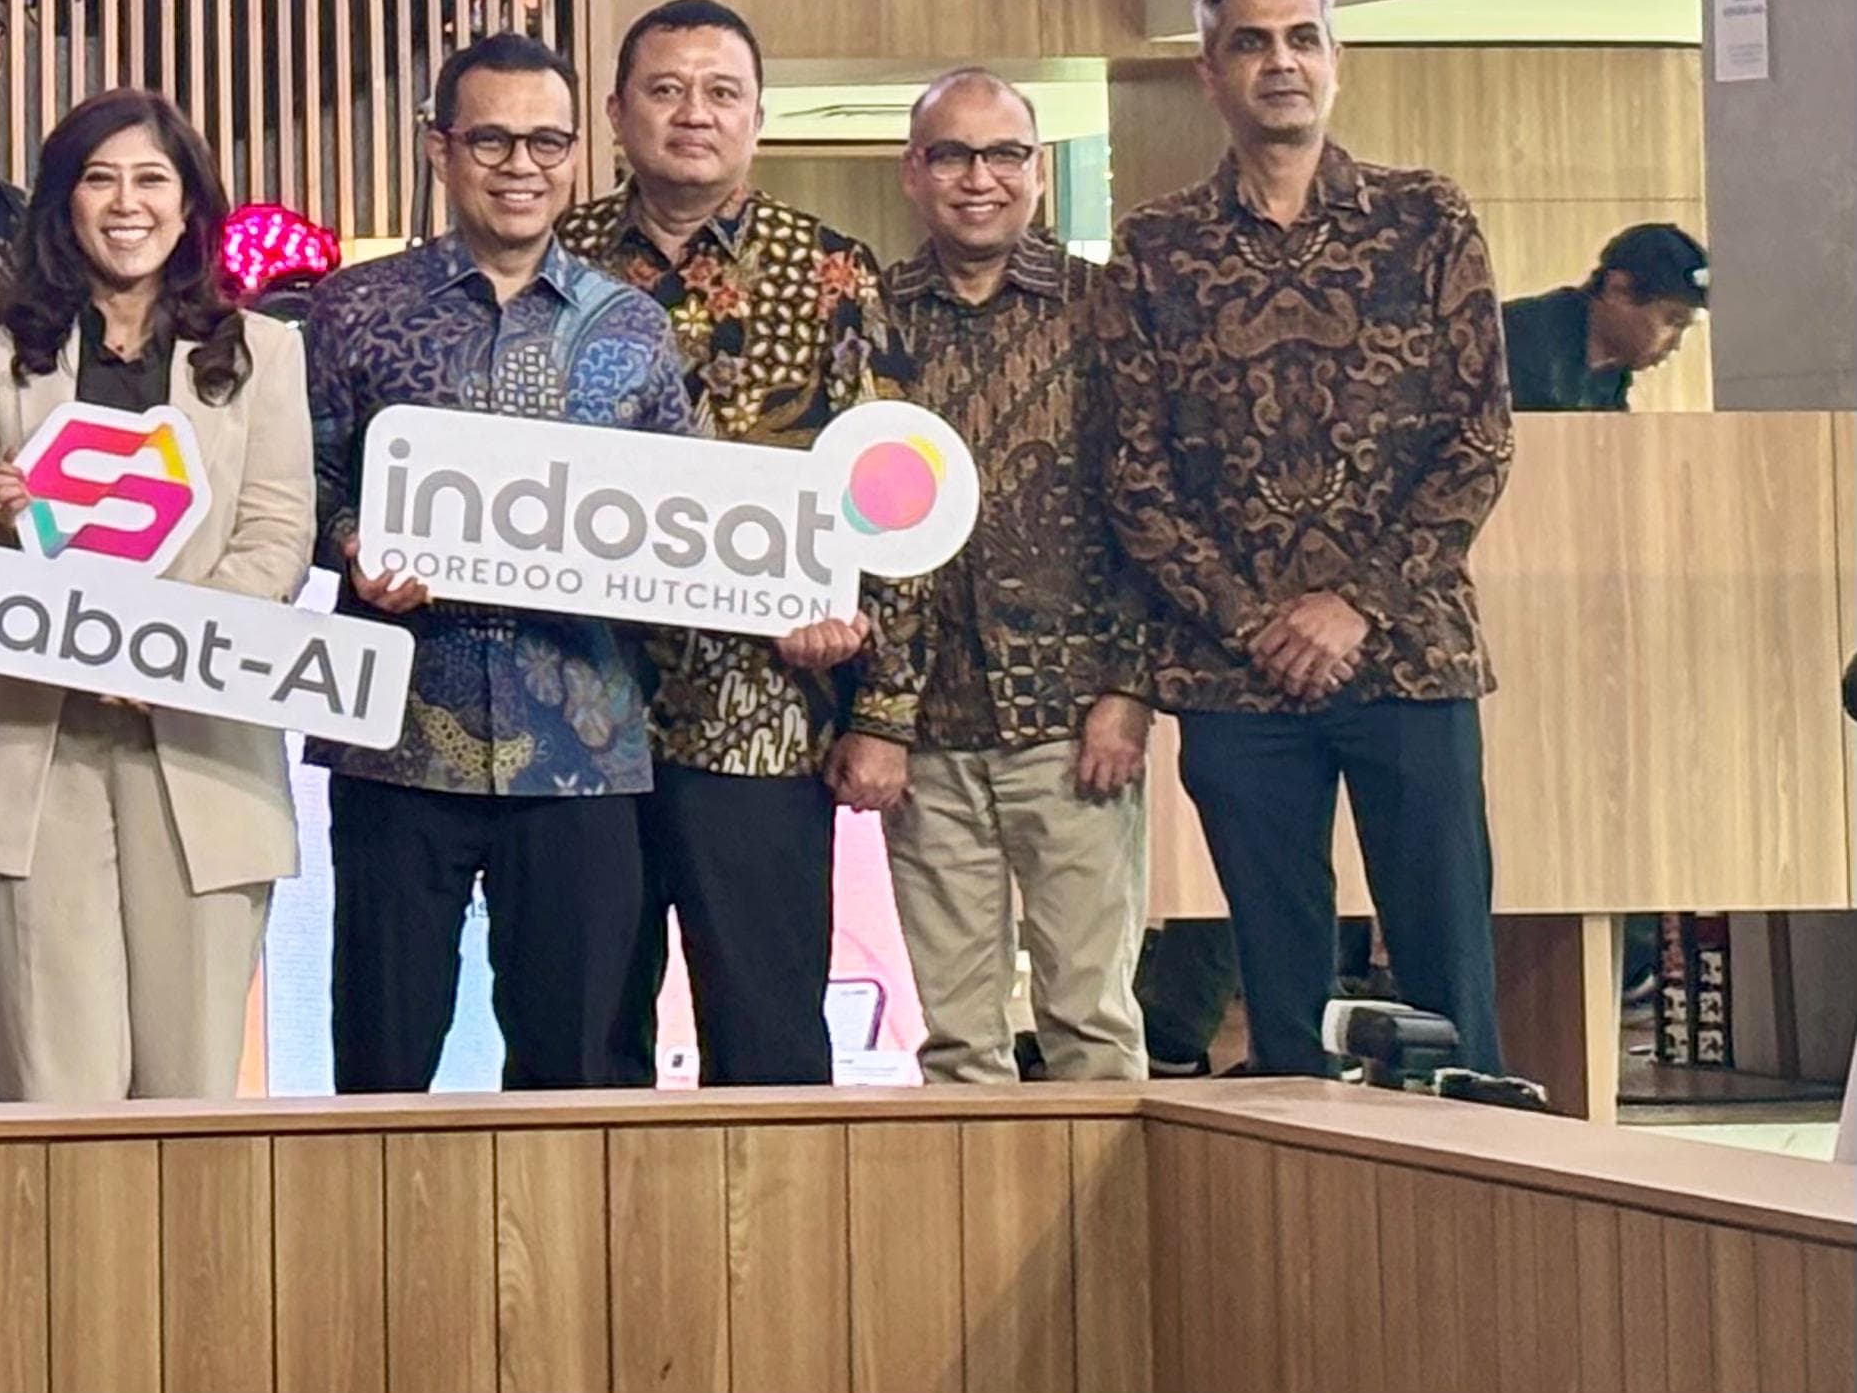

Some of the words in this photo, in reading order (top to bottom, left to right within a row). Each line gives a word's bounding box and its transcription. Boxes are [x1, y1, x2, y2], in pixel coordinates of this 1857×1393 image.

[383, 437, 836, 587] indosat
[380, 547, 583, 595] OOREDOO
[605, 572, 832, 626] HUTCHISON
